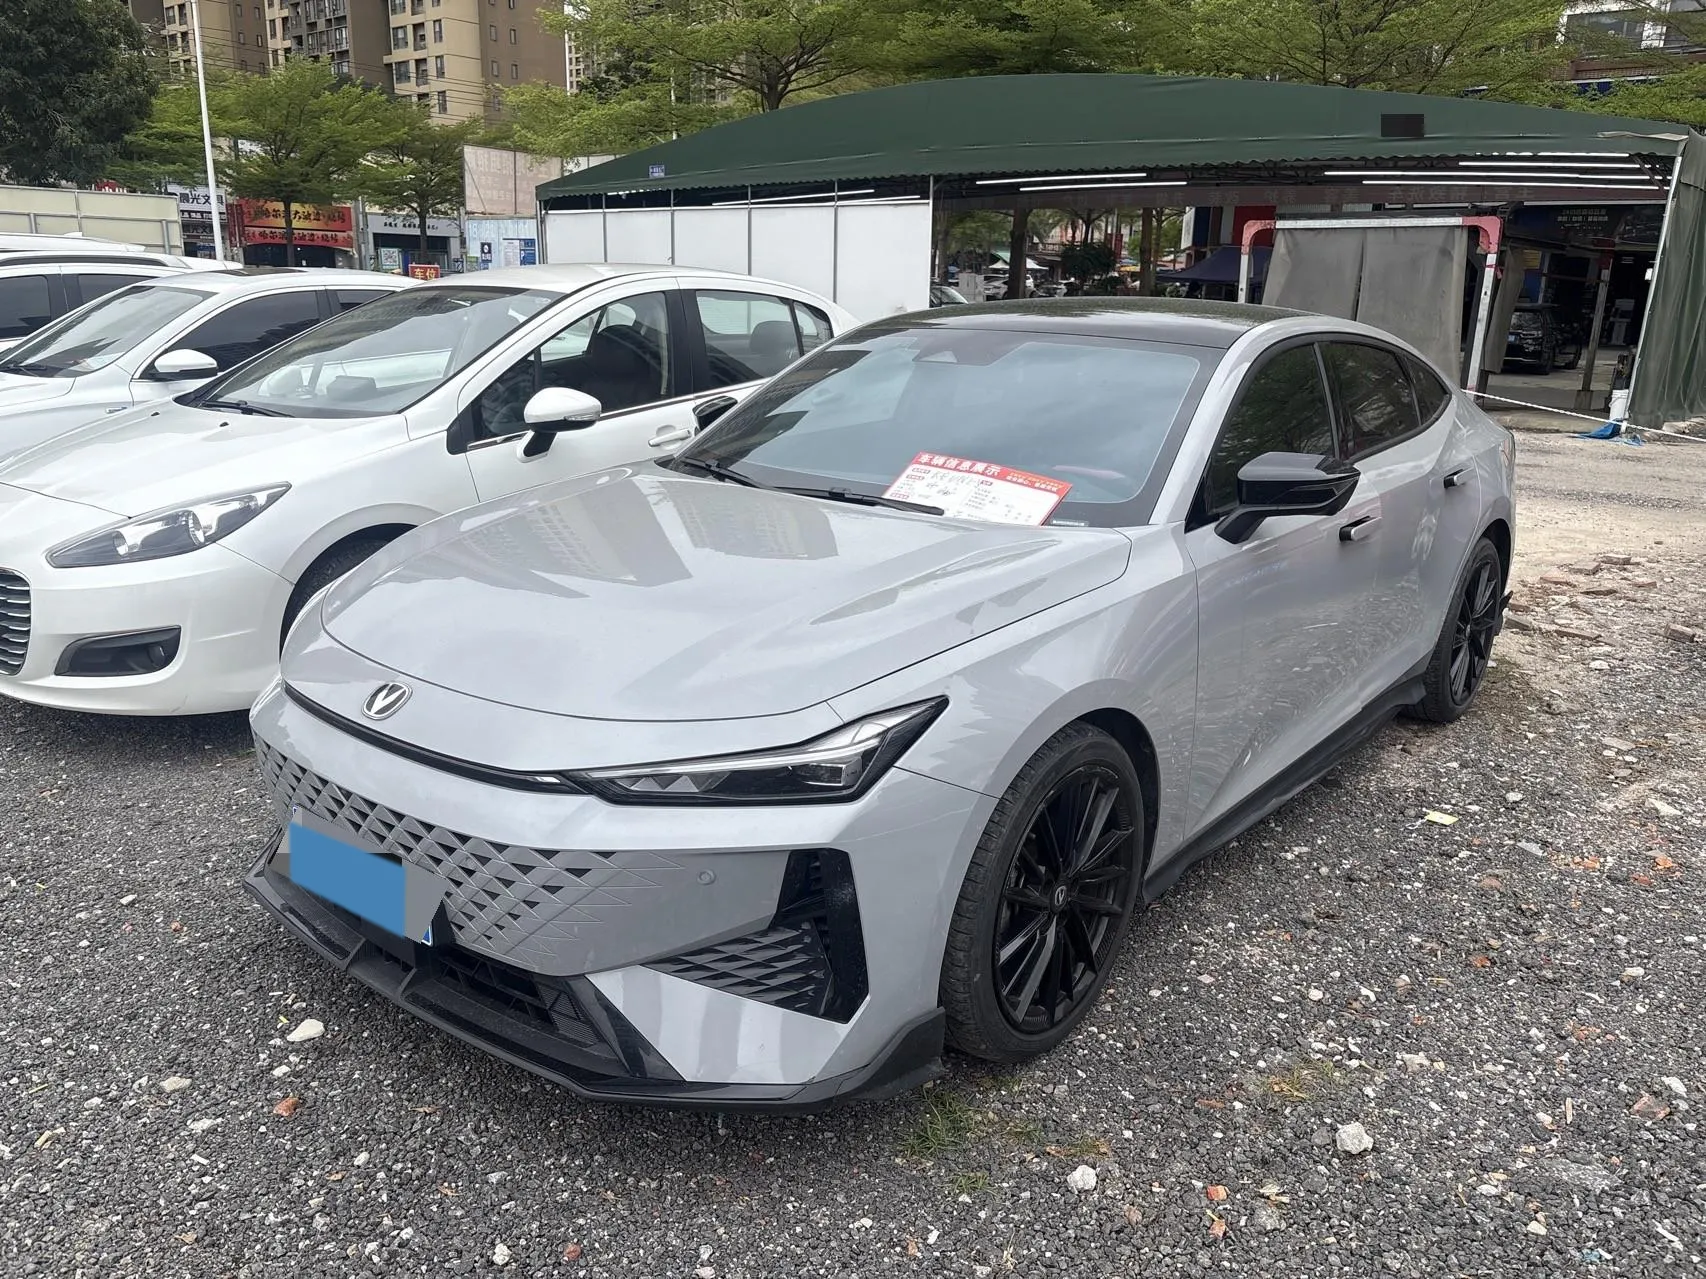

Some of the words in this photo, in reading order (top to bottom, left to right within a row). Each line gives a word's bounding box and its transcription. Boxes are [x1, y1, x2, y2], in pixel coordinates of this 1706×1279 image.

[414, 268, 436, 280] 车位
[918, 453, 1001, 477] 车辆信息展示
